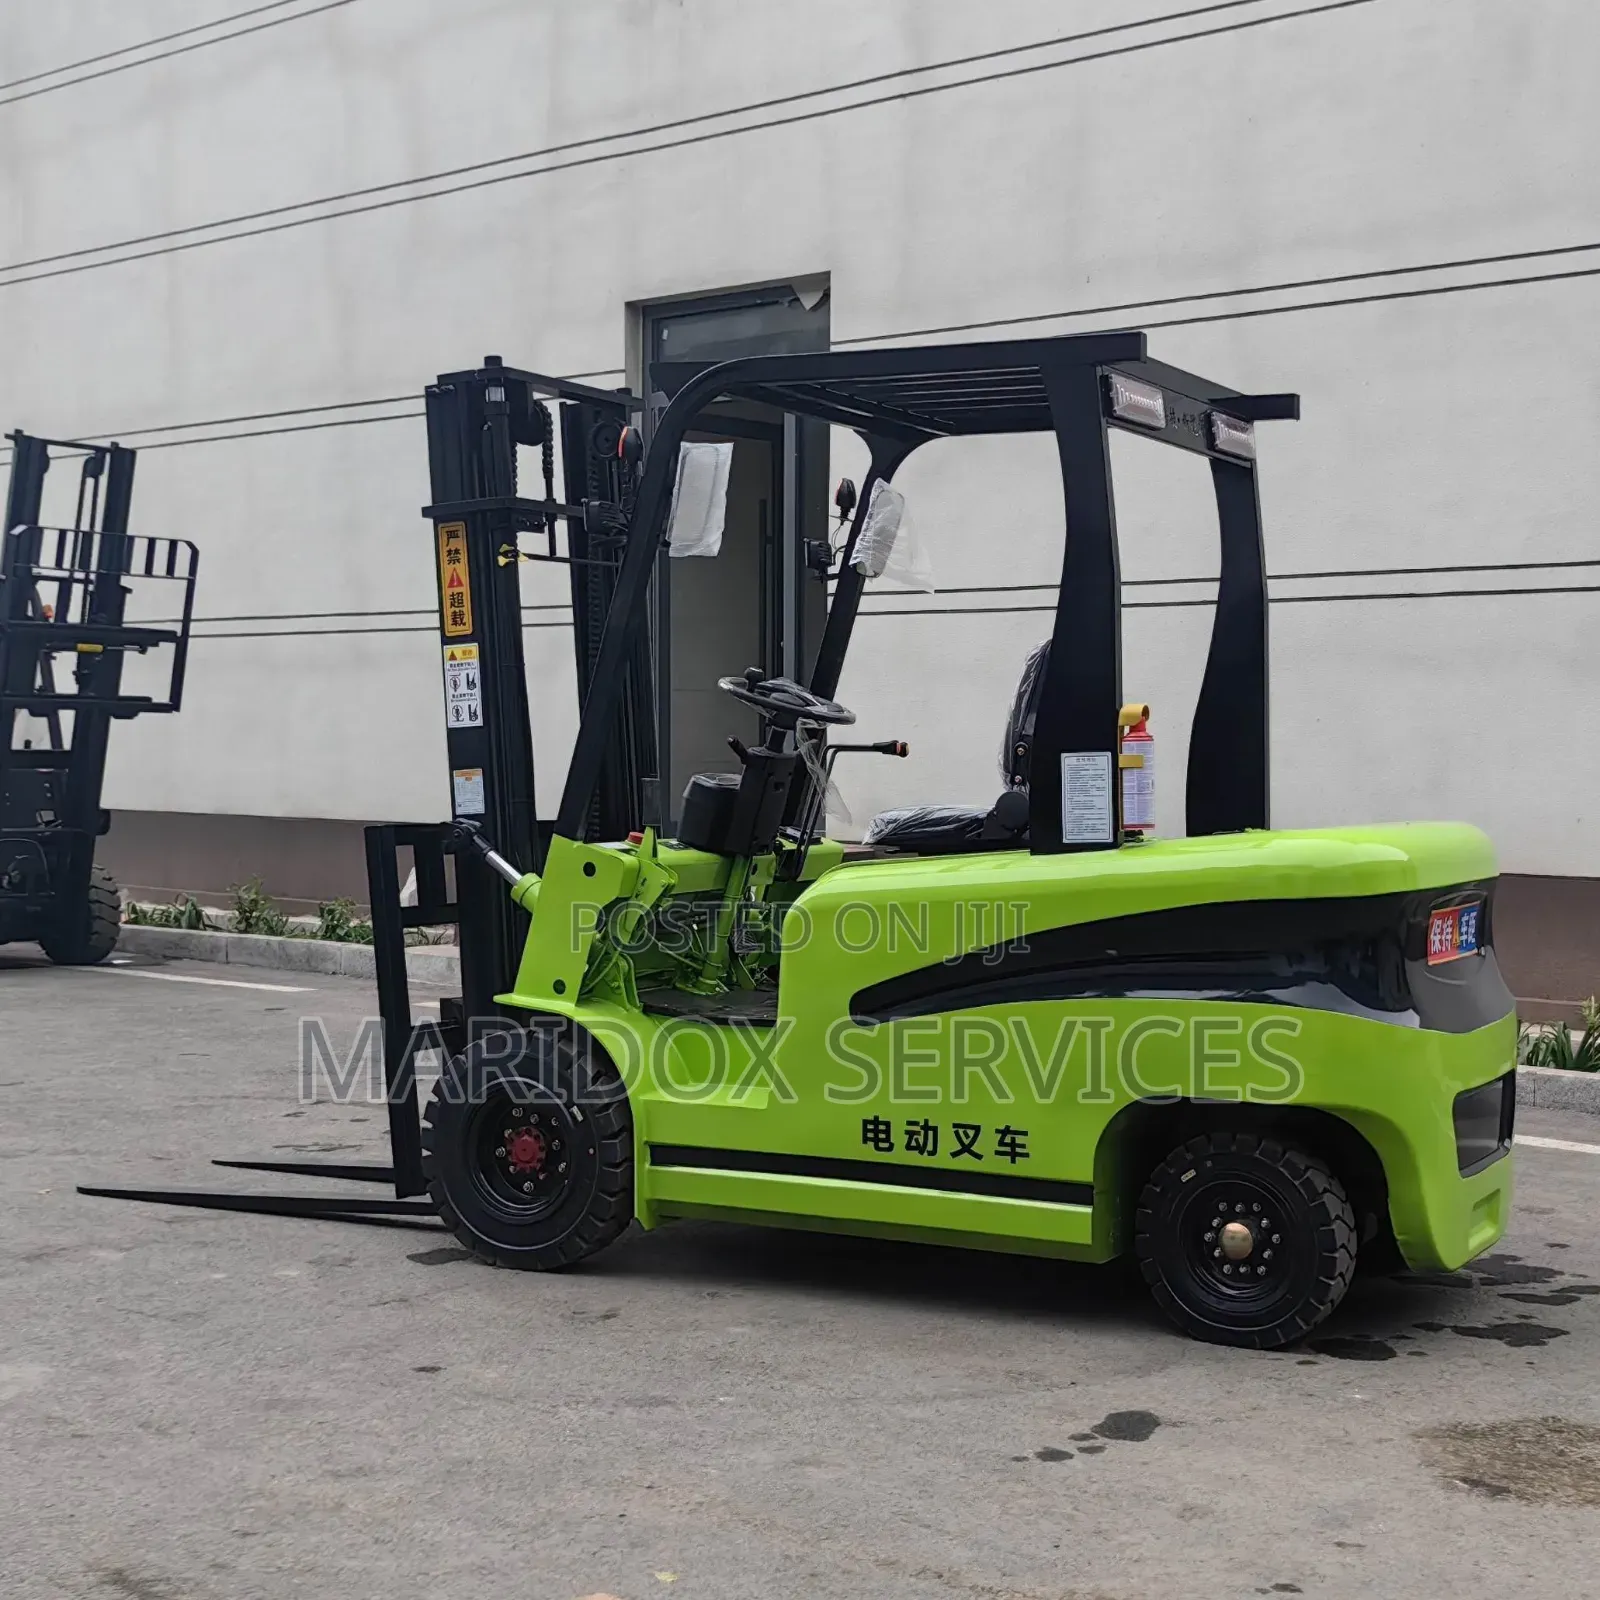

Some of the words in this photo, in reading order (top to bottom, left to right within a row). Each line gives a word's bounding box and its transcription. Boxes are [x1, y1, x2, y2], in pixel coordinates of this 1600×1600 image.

[445, 529, 466, 627] 严禁超载
[861, 1115, 1030, 1164] 电动叉车
